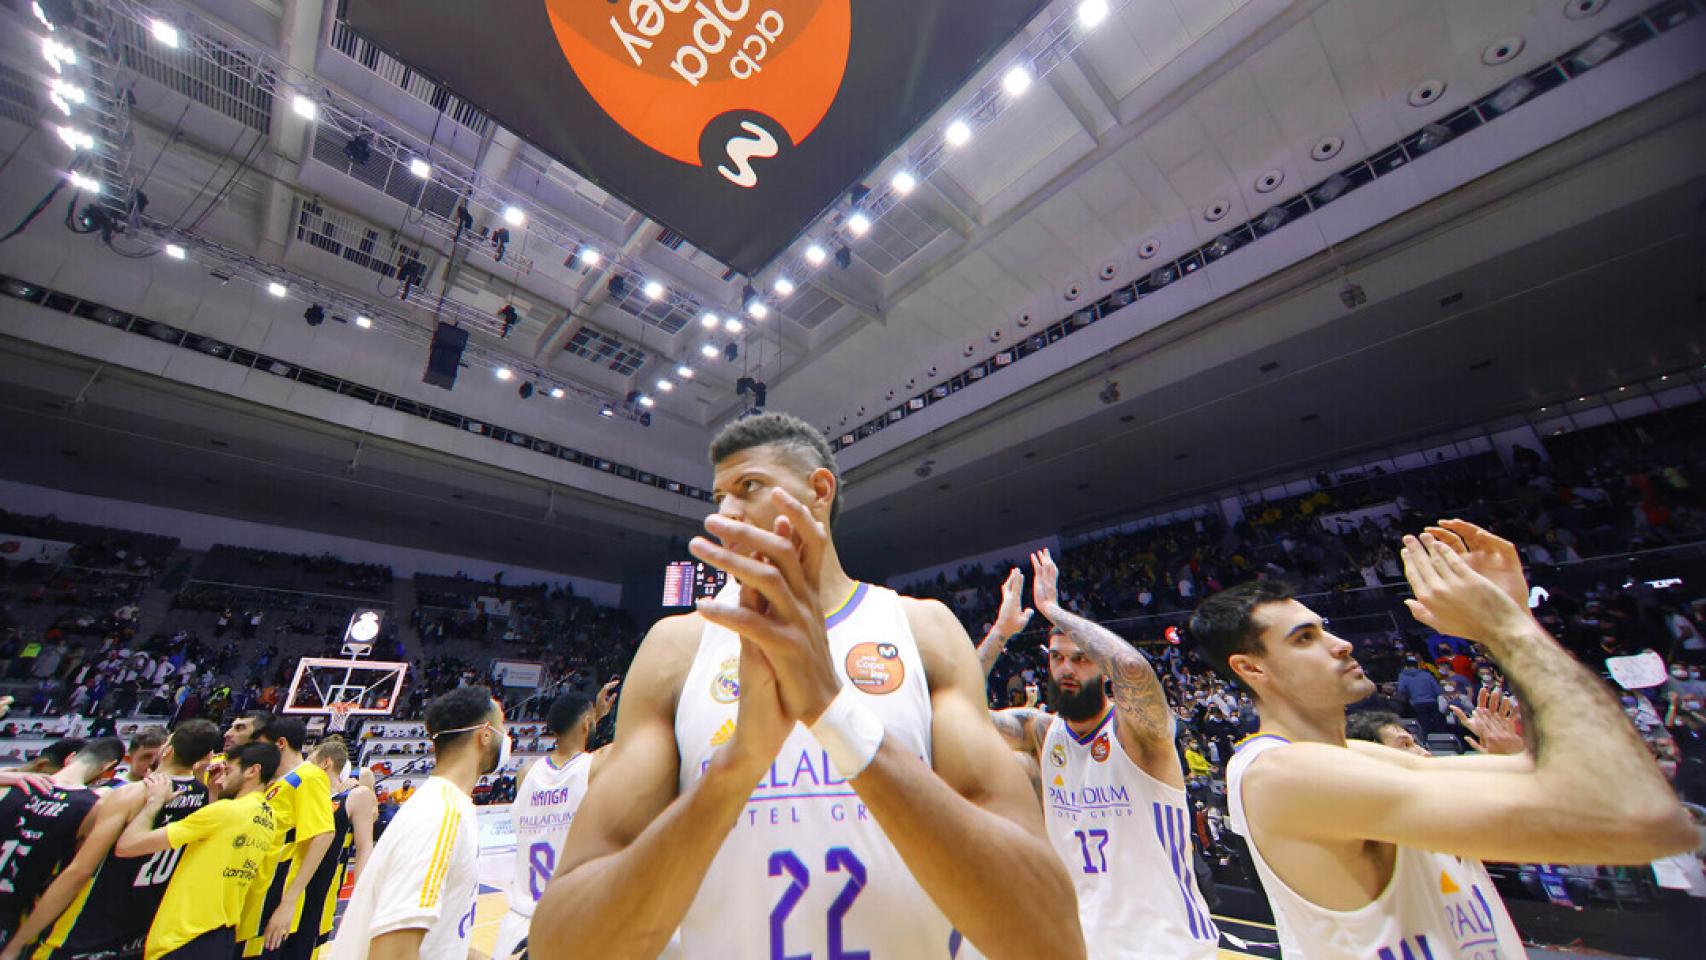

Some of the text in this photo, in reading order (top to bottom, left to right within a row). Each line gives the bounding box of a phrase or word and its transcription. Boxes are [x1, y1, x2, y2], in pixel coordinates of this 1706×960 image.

[729, 9, 785, 80] acb
[747, 804, 801, 826] TEL
[1049, 785, 1130, 807] PALLDIUM
[1073, 828, 1110, 874] 17
[767, 846, 871, 960] 22
